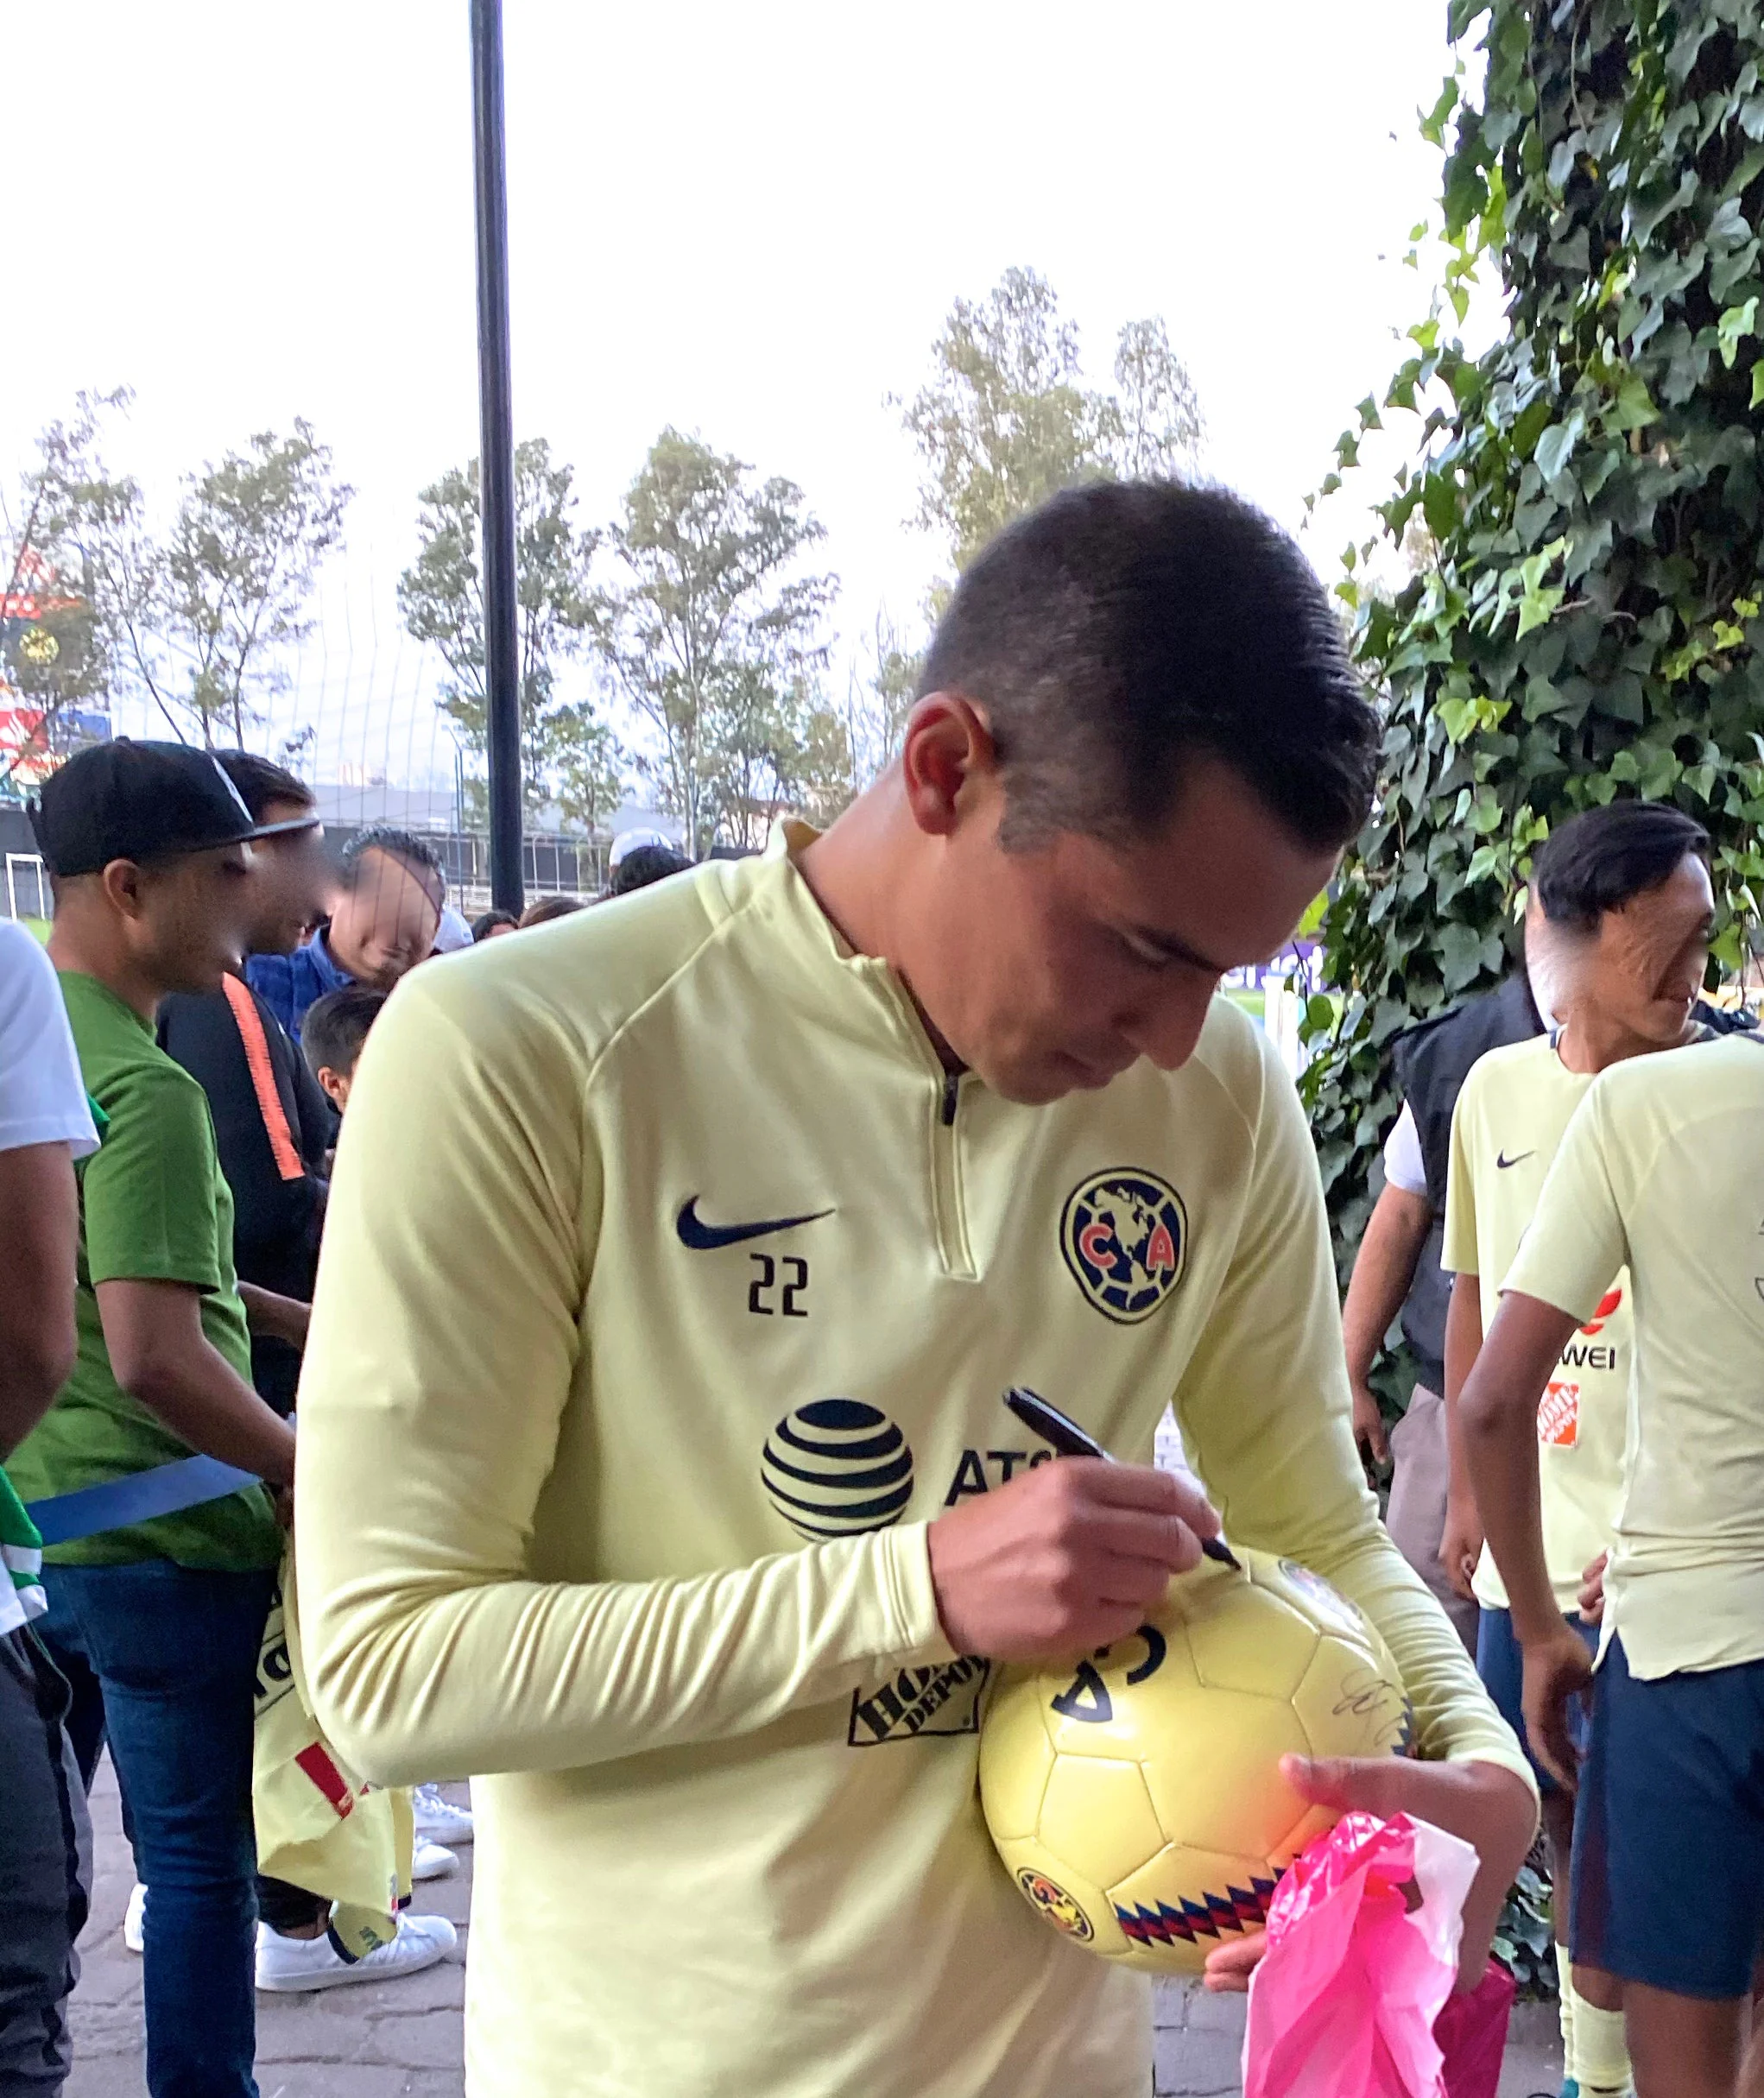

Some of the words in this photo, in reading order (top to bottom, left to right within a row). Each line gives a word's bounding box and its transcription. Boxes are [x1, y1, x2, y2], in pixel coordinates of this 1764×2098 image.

[749, 1252, 807, 1317] 22
[1559, 1343, 1615, 1370] WEI
[944, 1448, 1052, 1507] AT
[858, 1666, 941, 1741] HO
